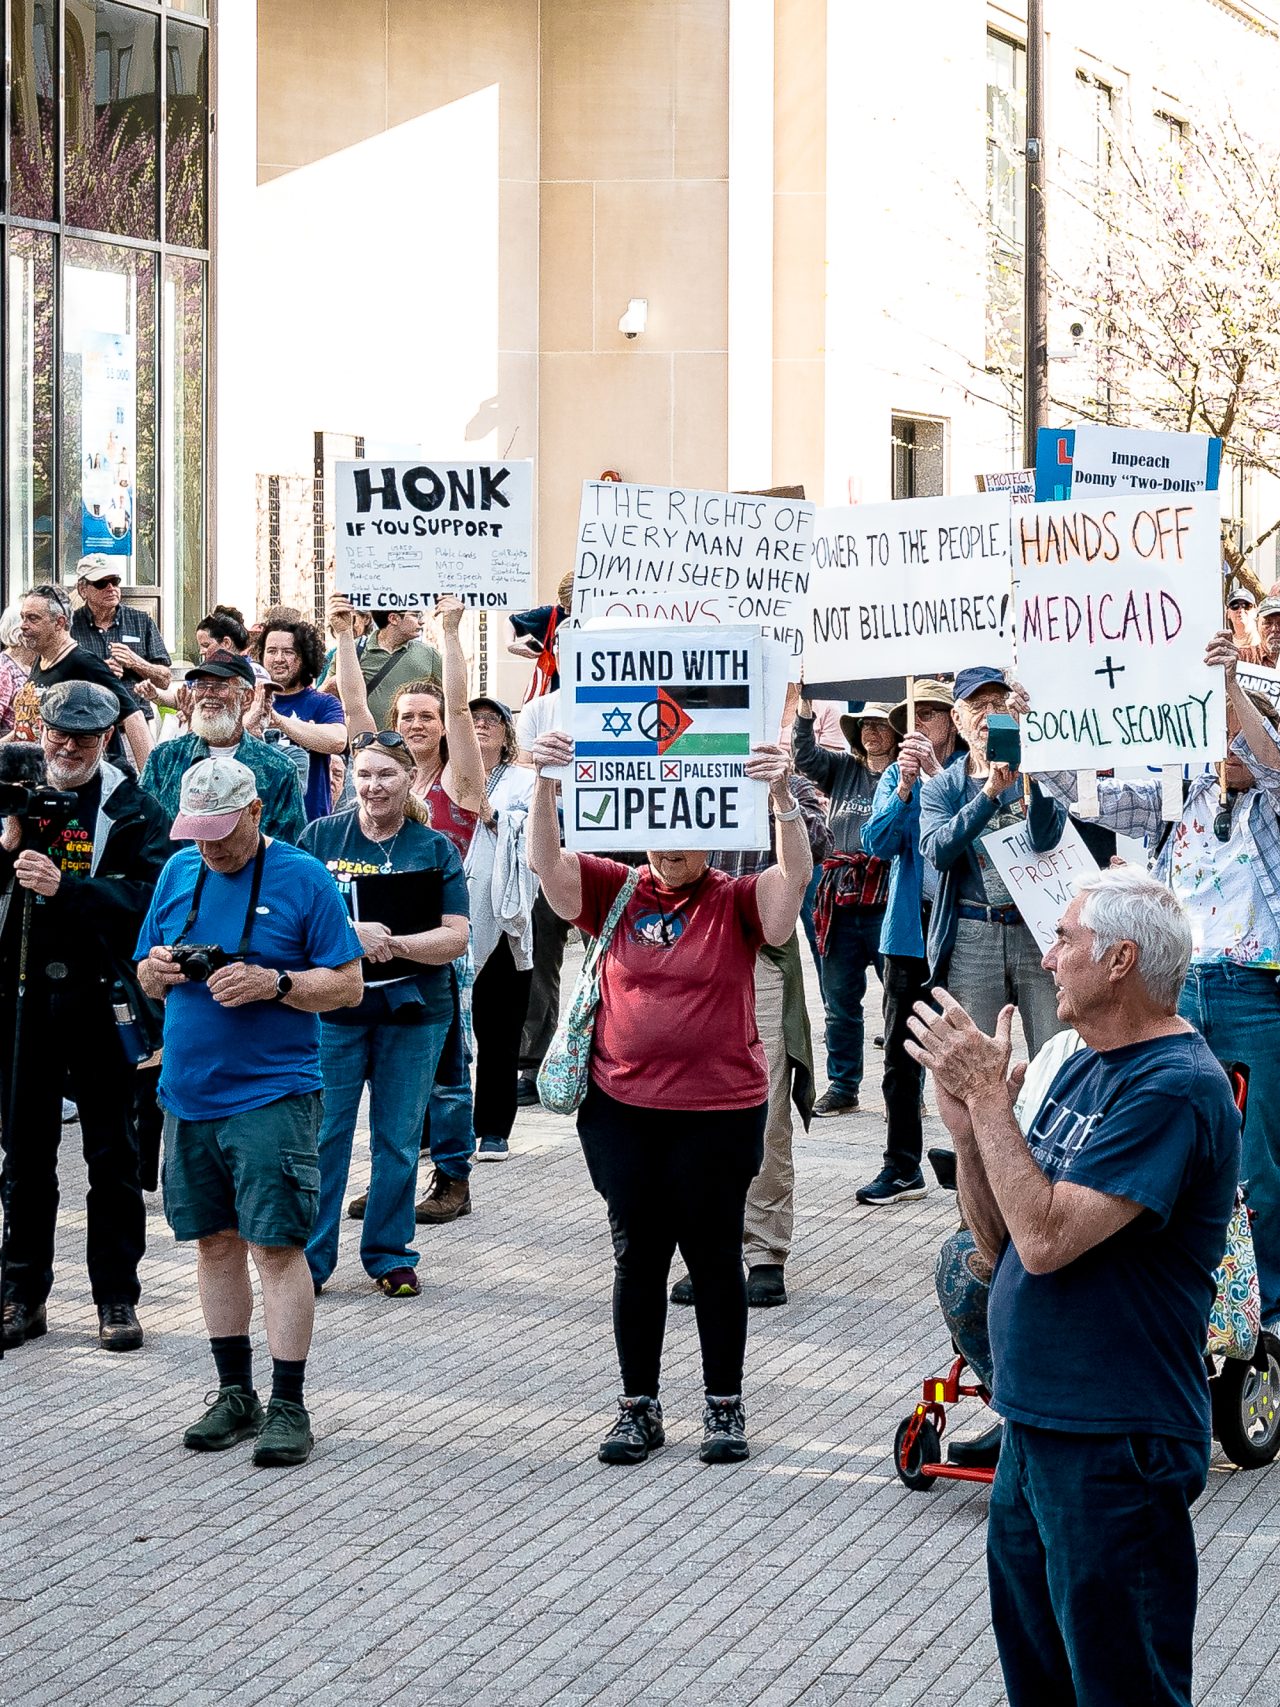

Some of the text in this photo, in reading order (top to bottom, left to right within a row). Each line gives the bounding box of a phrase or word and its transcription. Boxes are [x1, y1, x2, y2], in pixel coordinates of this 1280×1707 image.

[985, 471, 1031, 486] PROTECT
[1074, 470, 1117, 488] Donny
[1112, 451, 1170, 469] Impeach
[353, 466, 511, 513] HONK
[589, 484, 813, 534] THE RIGHTS OF
[1012, 485, 1034, 494] LANDS
[346, 515, 503, 537] IF YOU SUPPORT
[581, 523, 808, 562] EVERY MAN ARE
[867, 532, 889, 567] TO
[899, 529, 929, 564] THE
[938, 523, 1007, 562] PEOPLE,
[1019, 506, 1193, 565] HANDS OFF
[345, 546, 376, 557] DEI
[435, 561, 464, 570] NATO
[577, 551, 810, 594] DIMINISHED WHEN
[813, 606, 851, 644] NOT
[859, 593, 1010, 641] BILLIONAIRES!
[1022, 589, 1183, 646] MEDICAID
[576, 650, 748, 682] I STAND WITH
[1025, 690, 1213, 748] SOCIAL SECURITY
[600, 761, 656, 781] ISRAEL
[624, 787, 739, 830] PEACE
[338, 860, 379, 874] PEACE
[1009, 844, 1084, 890] PROFIT
